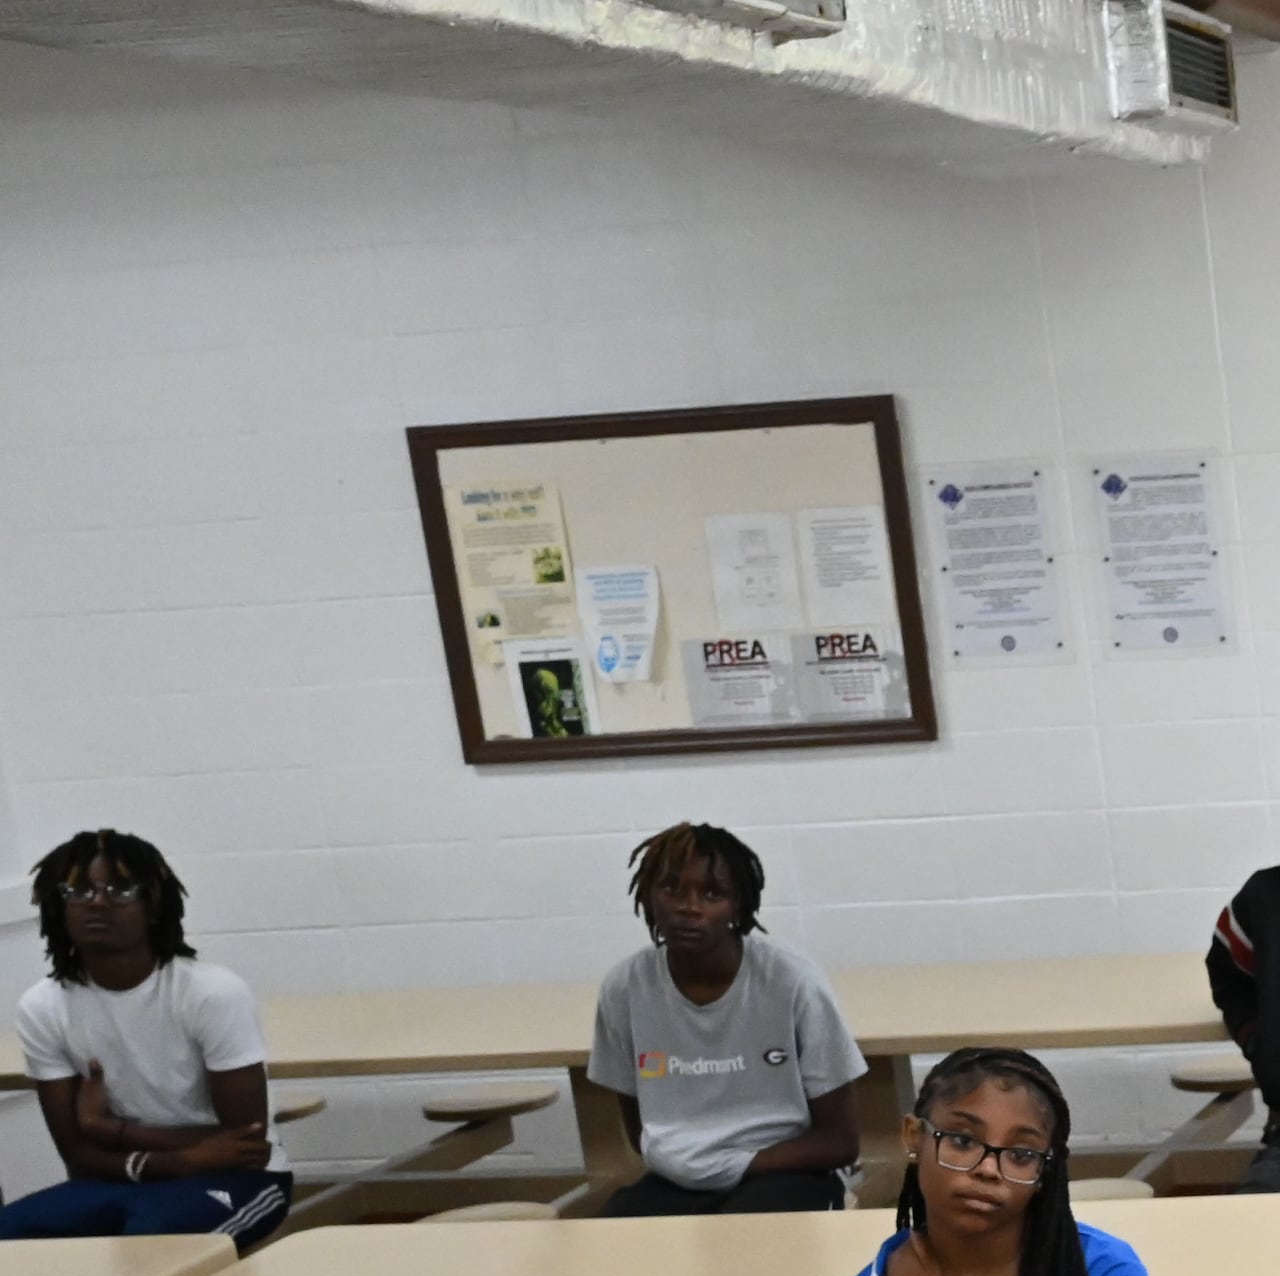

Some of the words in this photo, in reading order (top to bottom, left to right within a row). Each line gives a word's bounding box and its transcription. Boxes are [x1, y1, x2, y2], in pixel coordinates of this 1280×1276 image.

[702, 640, 767, 663] PREA
[814, 633, 878, 657] PREA
[668, 1055, 746, 1075] Piedmont
